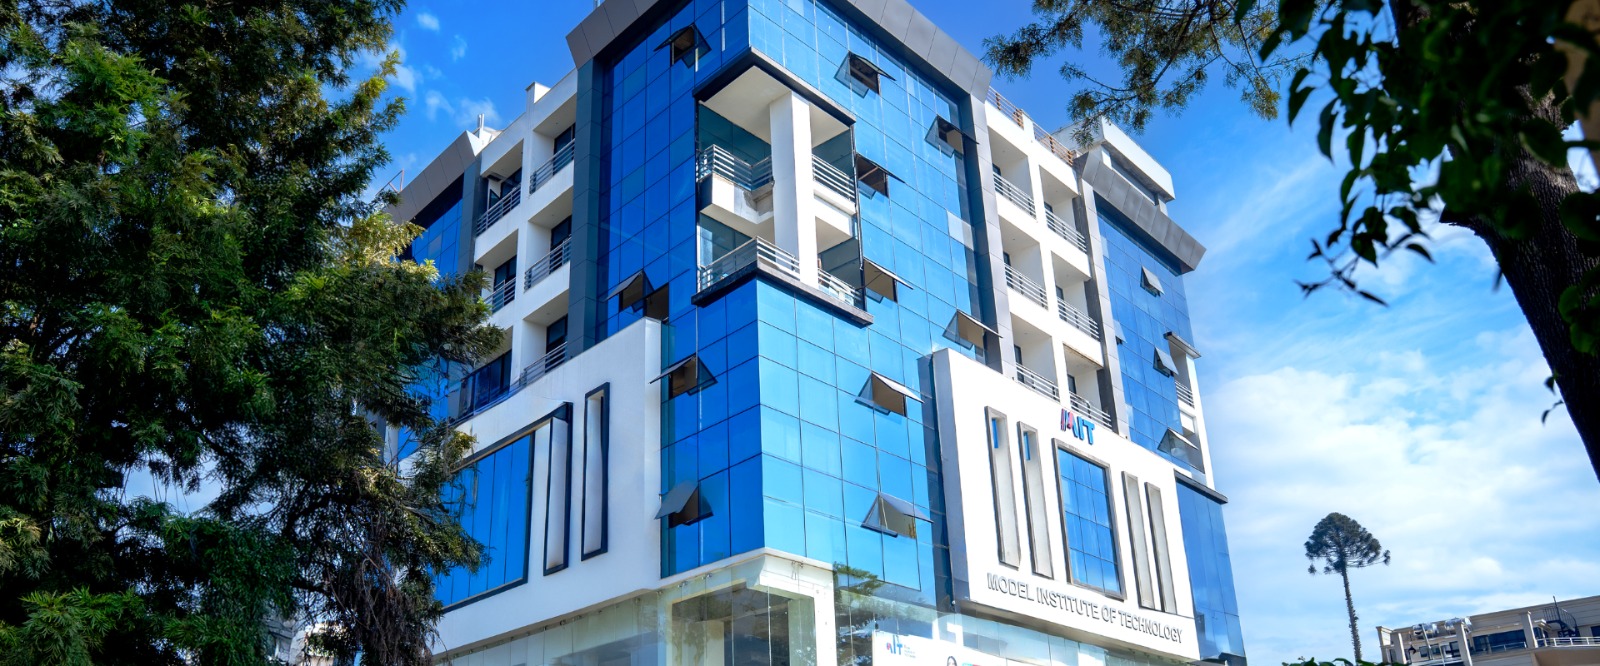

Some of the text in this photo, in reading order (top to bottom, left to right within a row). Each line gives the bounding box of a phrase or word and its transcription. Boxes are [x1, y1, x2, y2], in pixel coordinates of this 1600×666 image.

[987, 572, 1183, 643] MODEL INSTITUTE OF TECHNOLOGY
